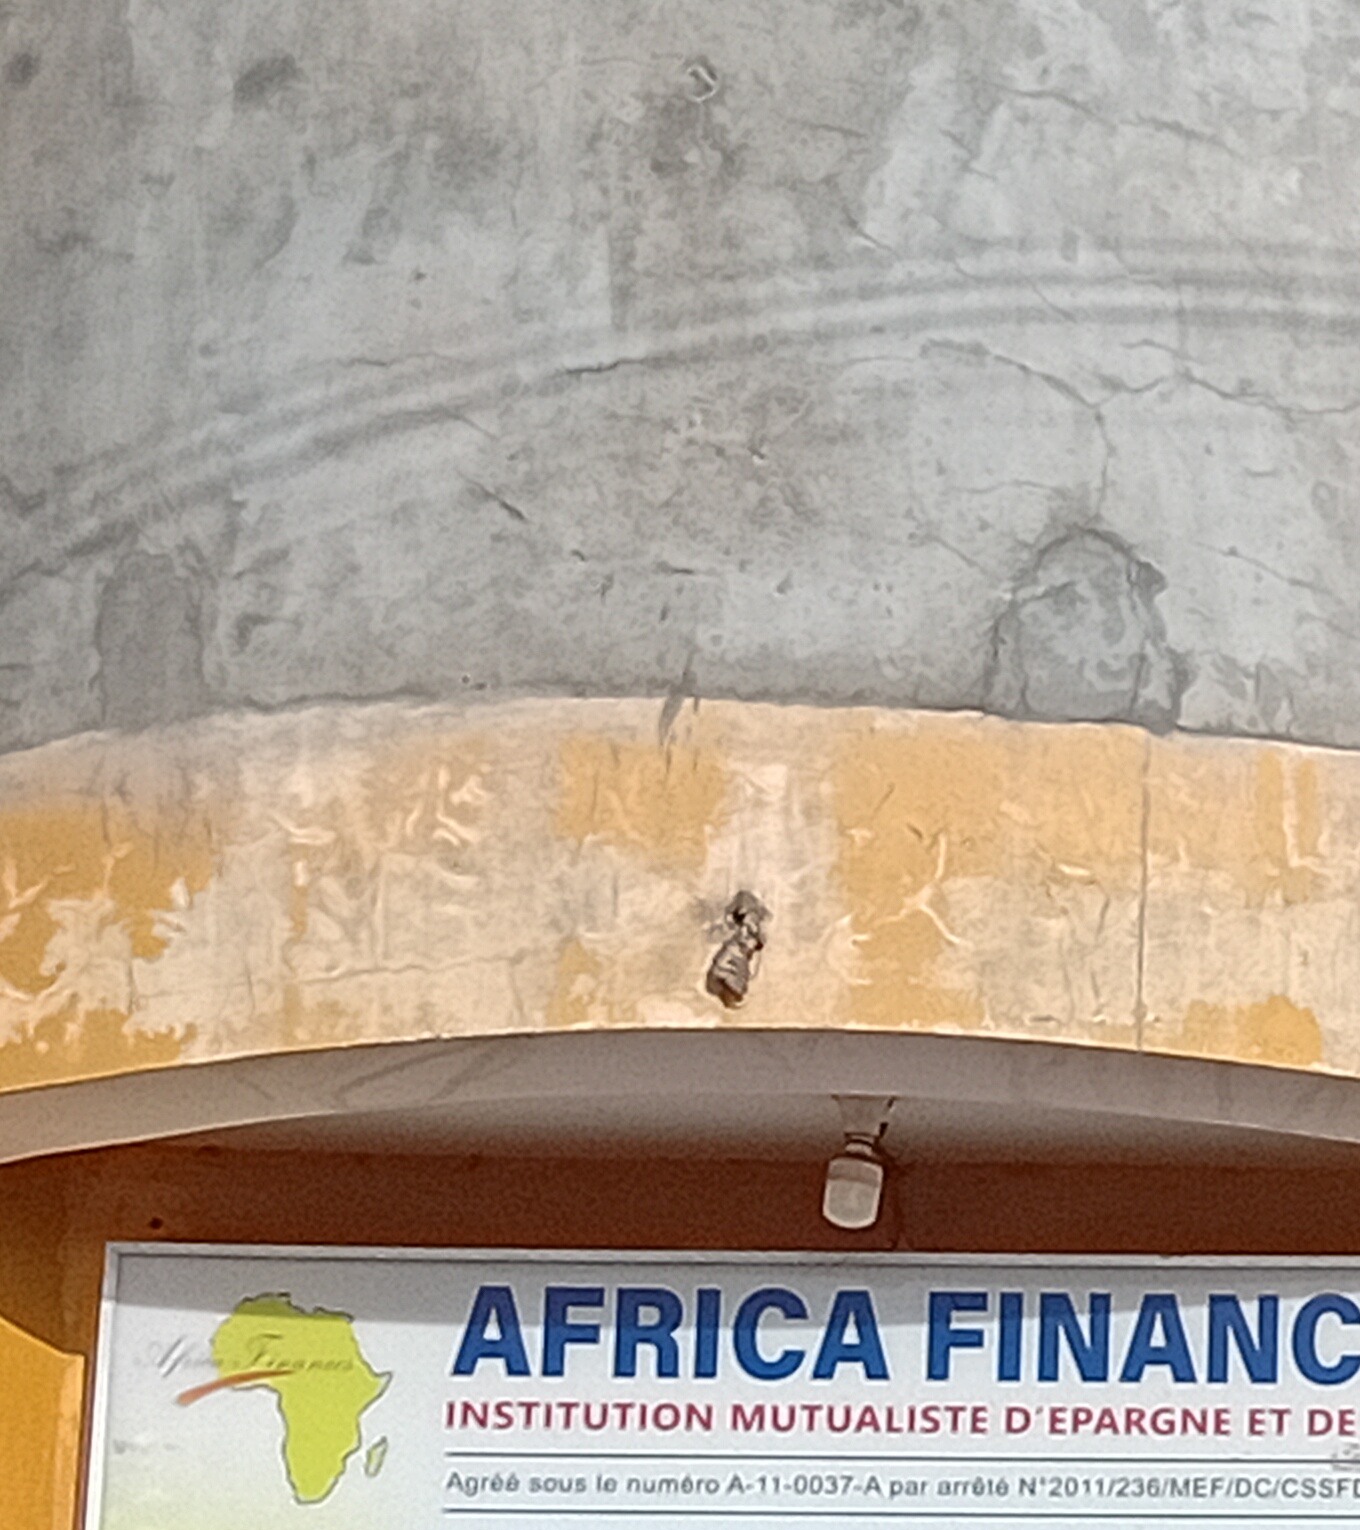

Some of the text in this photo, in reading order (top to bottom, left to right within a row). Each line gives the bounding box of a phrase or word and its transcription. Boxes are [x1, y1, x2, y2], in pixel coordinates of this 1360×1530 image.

[452, 1285, 889, 1382] AFRICA
[445, 1400, 713, 1432] INSTITUTION
[730, 1403, 989, 1435] MUTUALISTE
[1004, 1405, 1232, 1437] D'EPARGNE
[1248, 1407, 1292, 1437] ET
[1306, 1408, 1356, 1438] DE
[446, 1471, 520, 1497] Agréé
[528, 1475, 588, 1493] sous
[596, 1473, 618, 1494] le
[626, 1473, 720, 1496] numéro
[726, 1474, 882, 1496] A-11-0037-A
[889, 1478, 929, 1499] par
[937, 1475, 1009, 1497] arrêté
